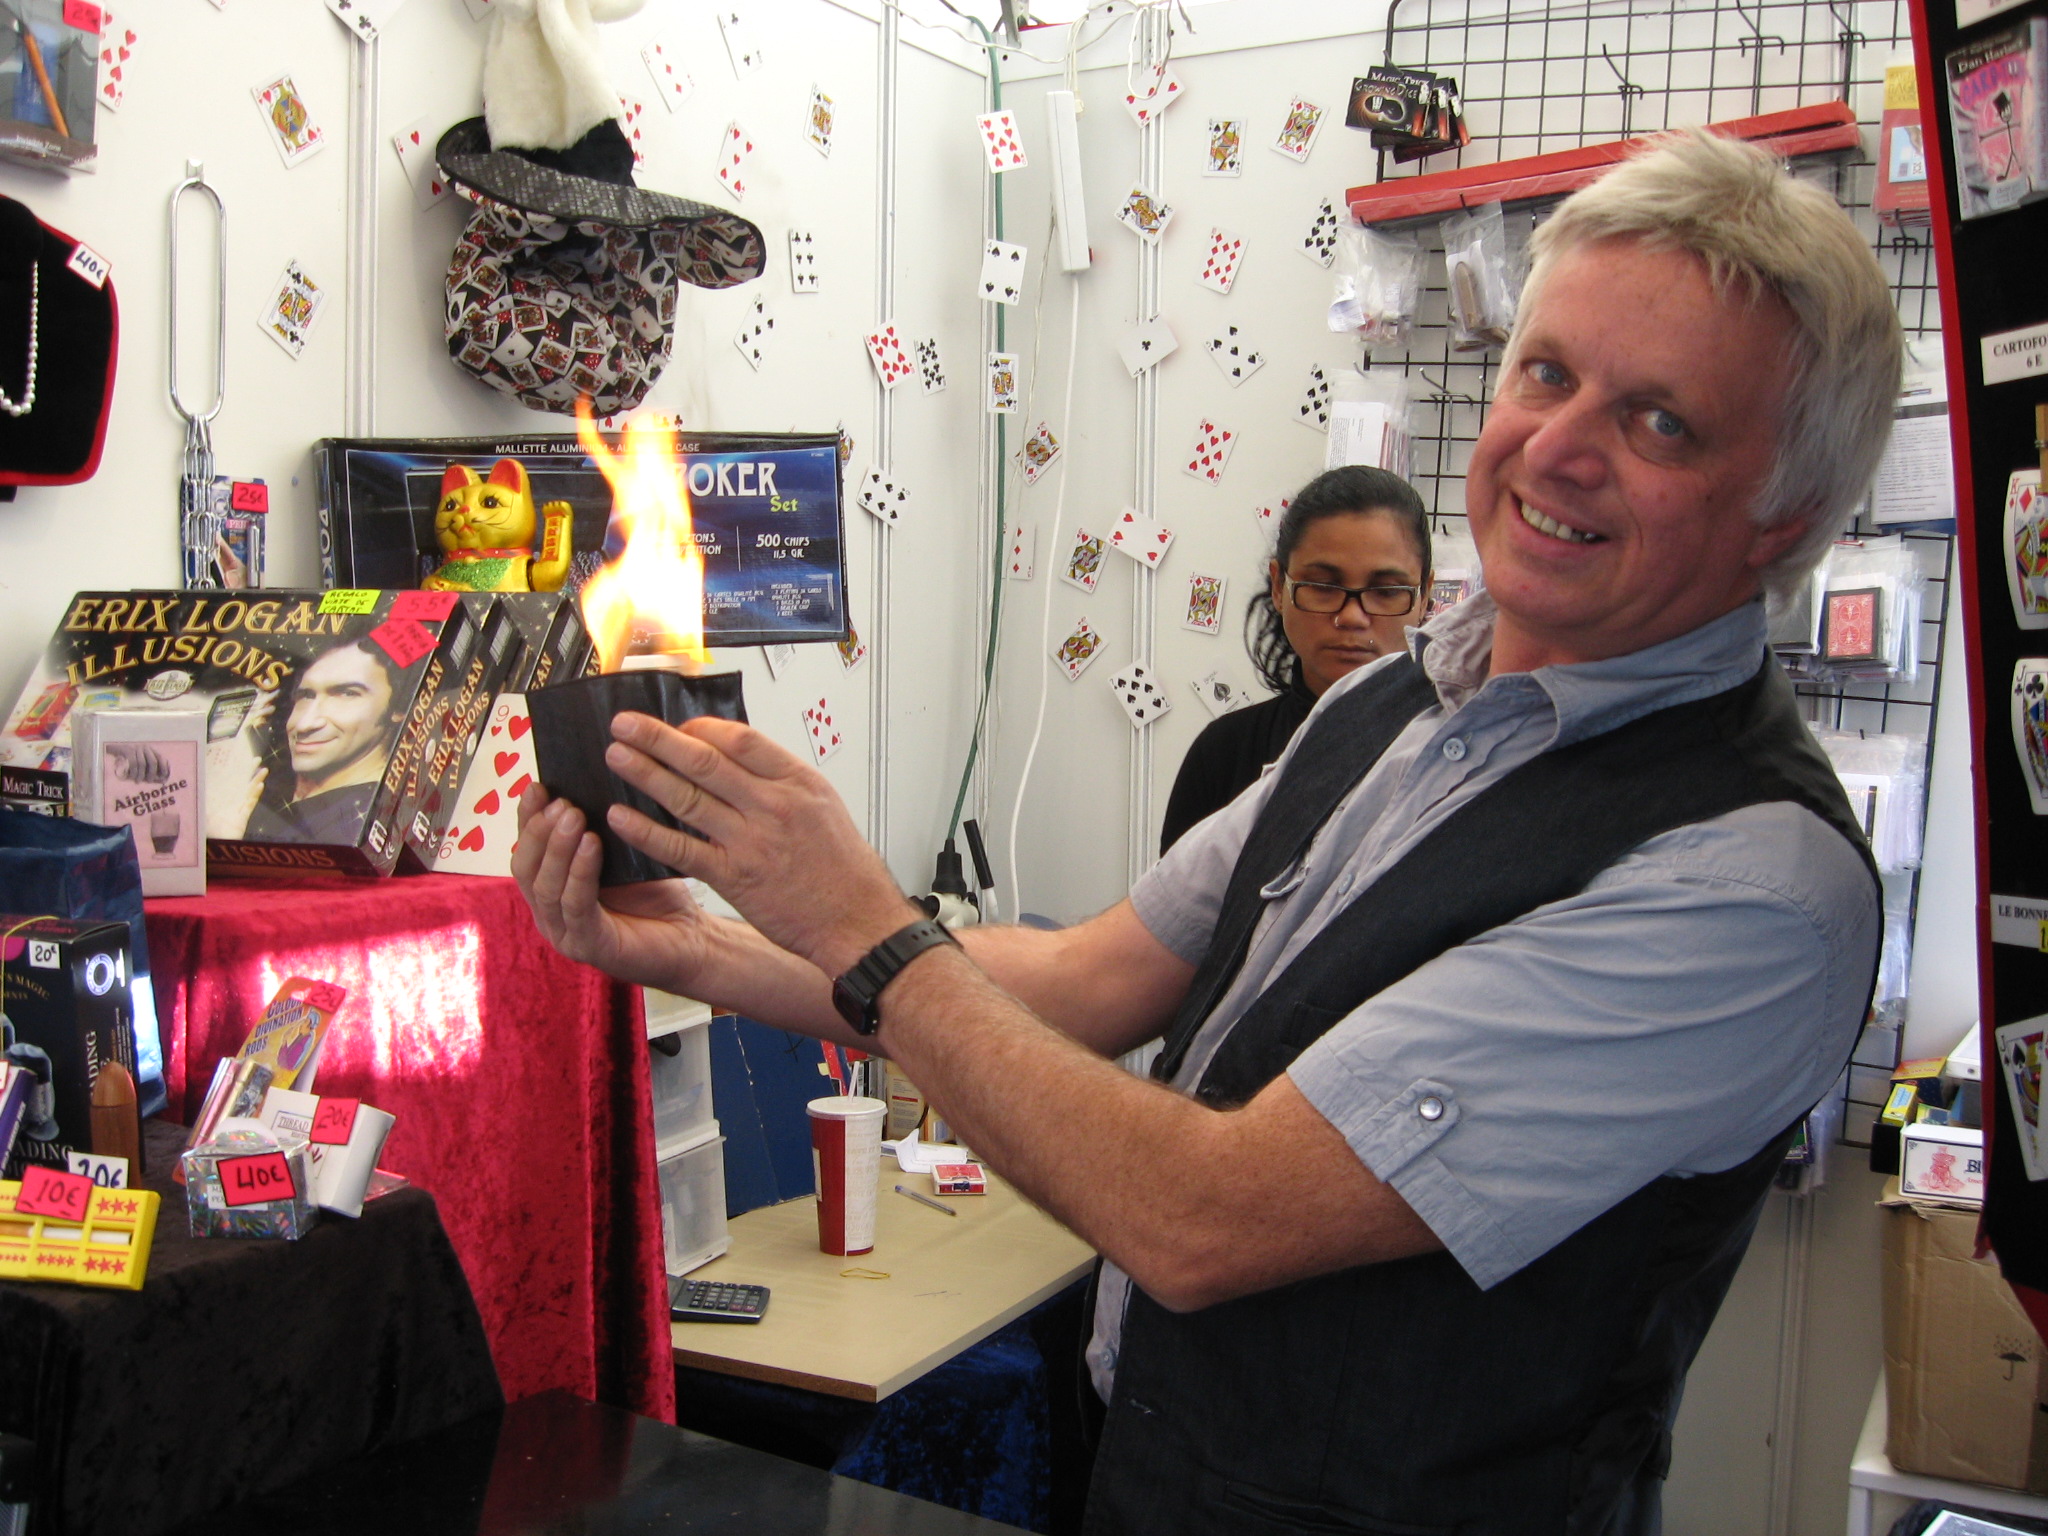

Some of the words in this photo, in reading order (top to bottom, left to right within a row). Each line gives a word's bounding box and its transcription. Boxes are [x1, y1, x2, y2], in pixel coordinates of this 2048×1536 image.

[1958, 58, 1983, 74] Dan
[1993, 335, 2048, 357] CARTOFO
[2026, 355, 2032, 368] 6
[2035, 354, 2042, 367] E
[495, 444, 547, 454] MALLETTE
[675, 443, 700, 452] CASE
[2010, 477, 2020, 495] K
[770, 495, 799, 512] Set
[755, 534, 781, 547] 500
[784, 536, 810, 547] CHIPS
[64, 598, 181, 634] ERIX
[180, 598, 348, 636] LOGAN
[65, 635, 294, 692] ILLUSIONS
[2016, 664, 2028, 683] J
[427, 730, 455, 787] ERIX
[449, 656, 485, 731] LOGAN
[495, 704, 510, 723] 9
[384, 734, 414, 794] ERIX
[407, 657, 445, 738] LOGAN
[406, 696, 451, 798] ILLUSIONS
[448, 691, 491, 790] ILLUSIONS
[2, 775, 34, 796] MAGIC
[37, 781, 65, 800] TRICK
[114, 779, 188, 812] Airborne
[132, 795, 176, 817] Glass
[1998, 904, 2012, 917] LE
[34, 944, 57, 962] 20€
[254, 1007, 304, 1039] DIVINATION
[244, 1036, 269, 1055] RODS
[2000, 1034, 2006, 1051] J
[279, 1116, 310, 1131] THREAD
[315, 1105, 349, 1130] 20€
[236, 1164, 286, 1190] 40€
[36, 1177, 81, 1208] 10€
